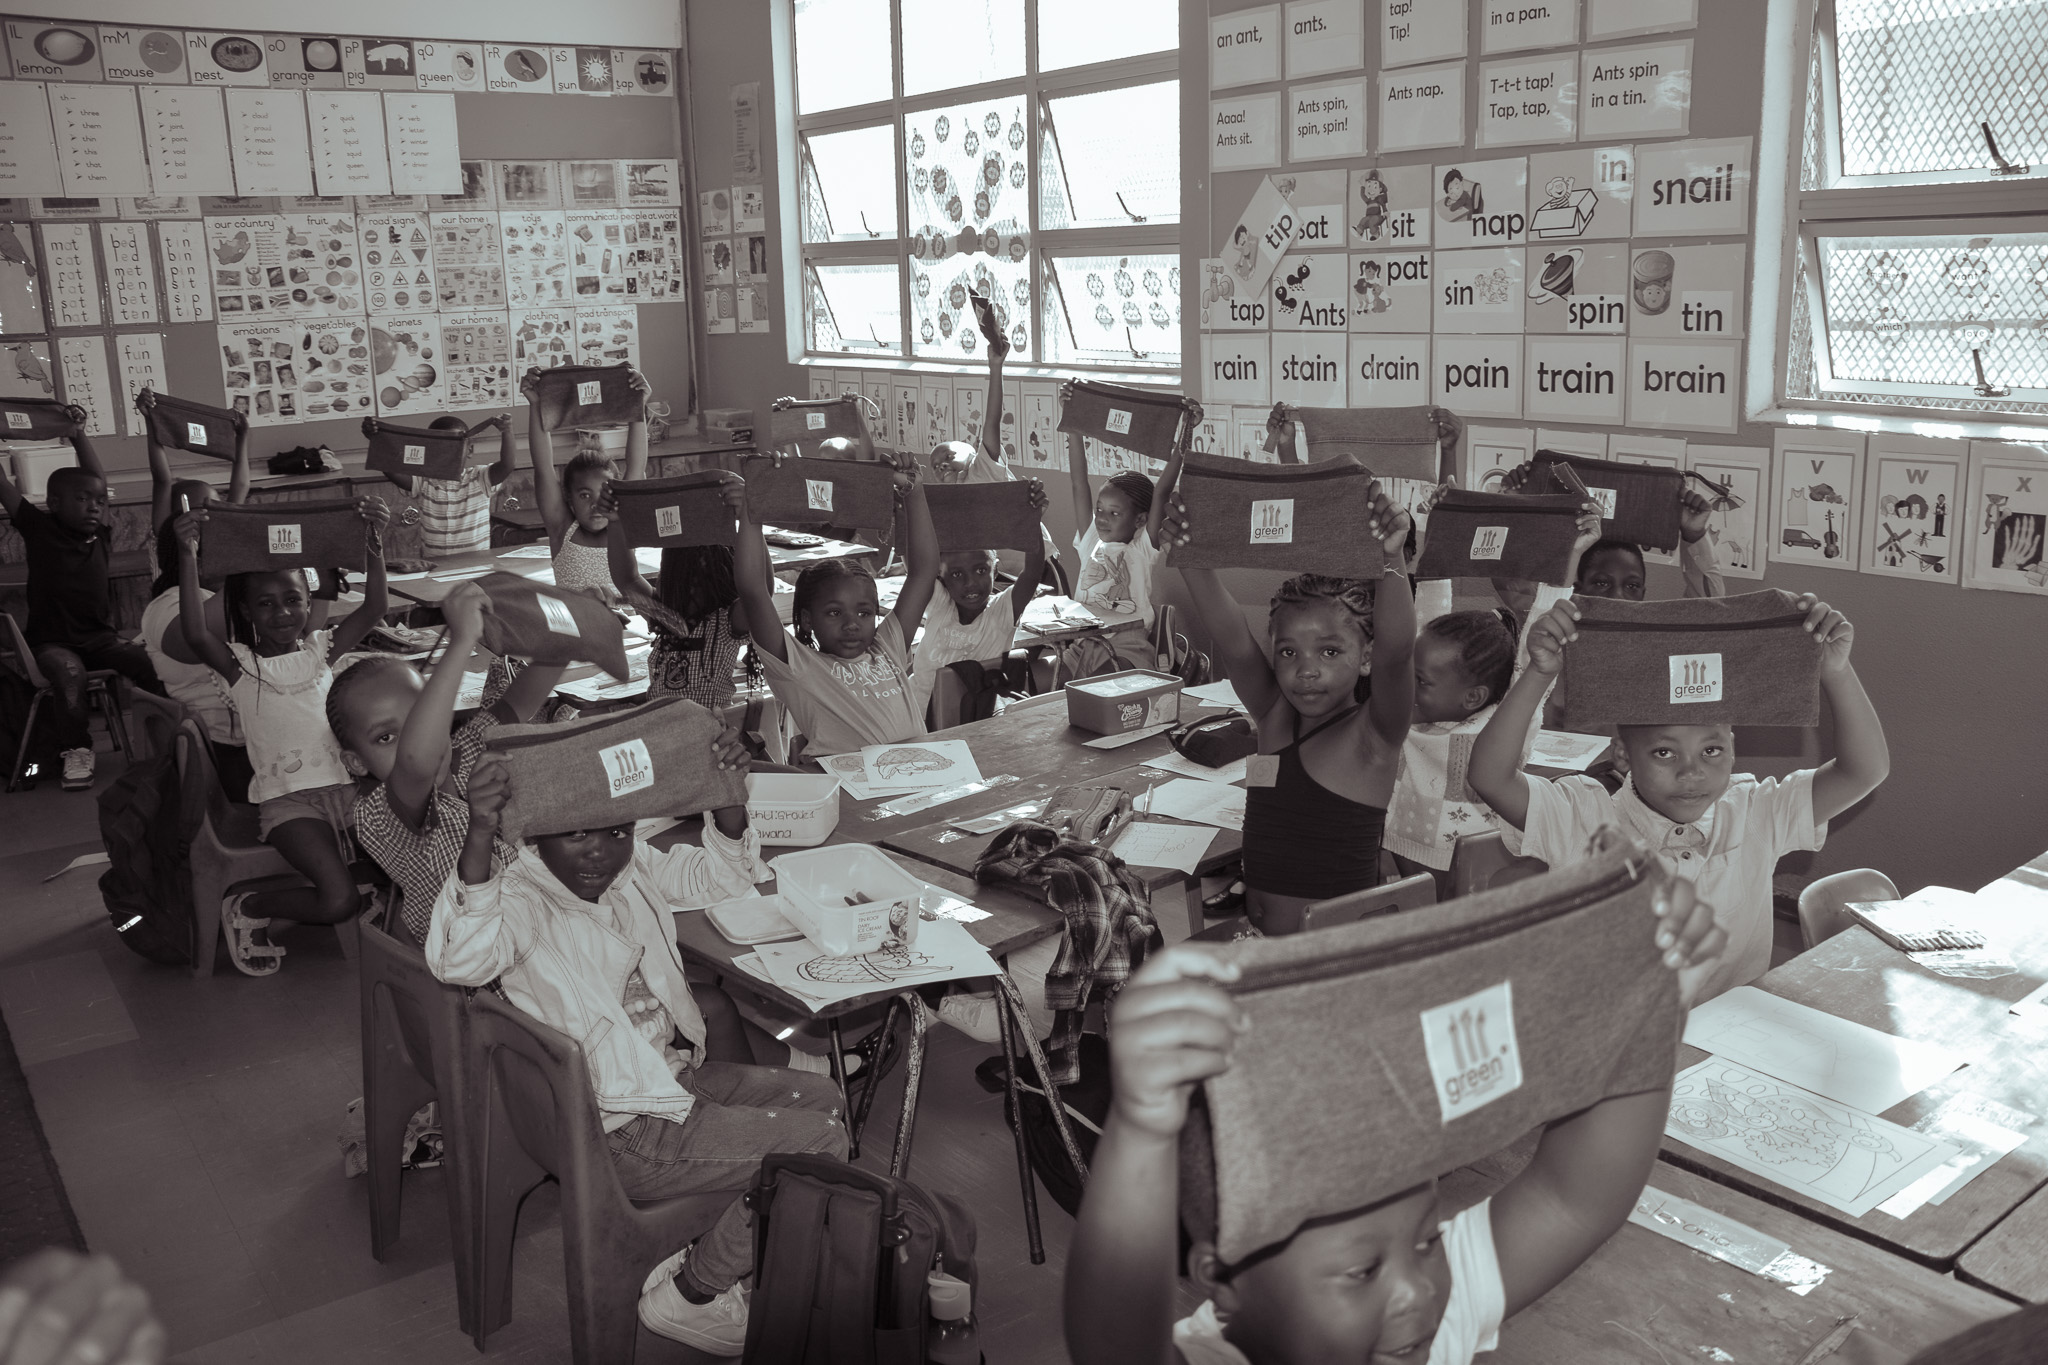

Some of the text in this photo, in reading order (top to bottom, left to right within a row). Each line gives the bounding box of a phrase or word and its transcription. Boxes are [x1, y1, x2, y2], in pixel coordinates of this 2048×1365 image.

[1390, 0, 1412, 16] tap!
[1492, 7, 1550, 25] in a pan.
[1294, 16, 1326, 35] ants.
[1390, 23, 1409, 41] Tip!
[103, 31, 130, 45] mM
[189, 35, 207, 49] nN
[1217, 26, 1262, 48] an ant,
[268, 39, 286, 52] oO
[345, 41, 359, 57] pP
[417, 45, 433, 60] qQ
[488, 46, 500, 58] rR
[555, 51, 567, 62] sS
[614, 52, 624, 63] tT
[17, 59, 62, 75] lemon
[109, 67, 154, 78] mouse
[1593, 62, 1658, 82] Ants spin
[195, 70, 224, 81] nest
[273, 71, 315, 85] orange
[347, 70, 365, 84] pig
[419, 72, 454, 87] queen
[490, 78, 517, 89] robin
[558, 80, 577, 90] sun
[616, 79, 634, 91] tap
[1491, 73, 1553, 93] T-t-t tap!
[1388, 85, 1443, 101] Ants nap.
[1592, 90, 1646, 107] in a tin.
[1298, 97, 1347, 114] Ants spin,
[1490, 102, 1550, 120] Tap, tap,
[1217, 110, 1245, 125] Aaaa!
[1298, 117, 1347, 138] spin, spin!
[1217, 133, 1252, 146] Ants sit.
[347, 150, 362, 158] squid
[1602, 154, 1627, 181] in
[1653, 164, 1733, 205] snail
[307, 216, 328, 225] fruit
[369, 216, 416, 228] road signs
[459, 215, 484, 223] home
[522, 213, 541, 225] toys
[621, 211, 647, 222] people
[235, 220, 274, 231] country
[1265, 214, 1293, 250] tip
[1300, 216, 1328, 239] sat
[1392, 213, 1415, 238] sit
[1472, 211, 1524, 239] nap
[51, 239, 79, 251] mat
[110, 234, 137, 248] bed
[165, 237, 190, 248] tin
[56, 253, 81, 265] cat
[115, 248, 138, 262] led
[167, 247, 191, 261] bin
[59, 269, 83, 282] rat
[115, 266, 141, 277] met
[171, 266, 195, 283] pin
[1388, 255, 1428, 286] pat
[57, 281, 85, 294] fat
[117, 276, 147, 290] den
[172, 278, 196, 289] sit
[118, 290, 147, 305] bet
[1445, 280, 1473, 305] sin
[61, 297, 86, 308] sat
[174, 294, 200, 308] sip
[62, 309, 88, 322] hat
[121, 308, 149, 320] ten
[177, 306, 202, 321] tip
[468, 315, 493, 323] home
[525, 310, 559, 323] clothing
[576, 308, 635, 319] road transport
[1230, 300, 1264, 325] tap
[1299, 301, 1345, 326] Ants
[1569, 296, 1623, 329] spin
[1682, 303, 1722, 331] tin
[304, 320, 356, 333] vegetables
[388, 318, 423, 328] planets
[233, 326, 280, 336] emotions
[63, 353, 86, 363] cot
[125, 345, 150, 360] fun
[66, 364, 88, 377] lot
[129, 364, 152, 373] run
[1214, 355, 1256, 380] rain
[1283, 354, 1336, 381] stain
[1362, 354, 1418, 380] drain
[1446, 358, 1508, 393] pain
[1538, 362, 1613, 394] train
[1645, 361, 1725, 393] brain
[69, 381, 93, 392] not
[130, 378, 155, 388] sun
[875, 386, 880, 397] d
[903, 391, 907, 399] e
[934, 390, 939, 407] f
[967, 391, 972, 405] g
[1037, 398, 1041, 411] i
[1203, 424, 1215, 435] m
[1254, 430, 1262, 440] n
[1496, 452, 1503, 465] r
[1811, 460, 1824, 474] v
[1720, 474, 1734, 487] u
[1906, 469, 1929, 484] w
[2016, 477, 2032, 492] x
[1255, 527, 1283, 538] green
[272, 542, 296, 550] green
[1473, 546, 1495, 554] green
[1675, 685, 1711, 698] green
[614, 771, 644, 791] green
[1445, 1056, 1504, 1105] green
